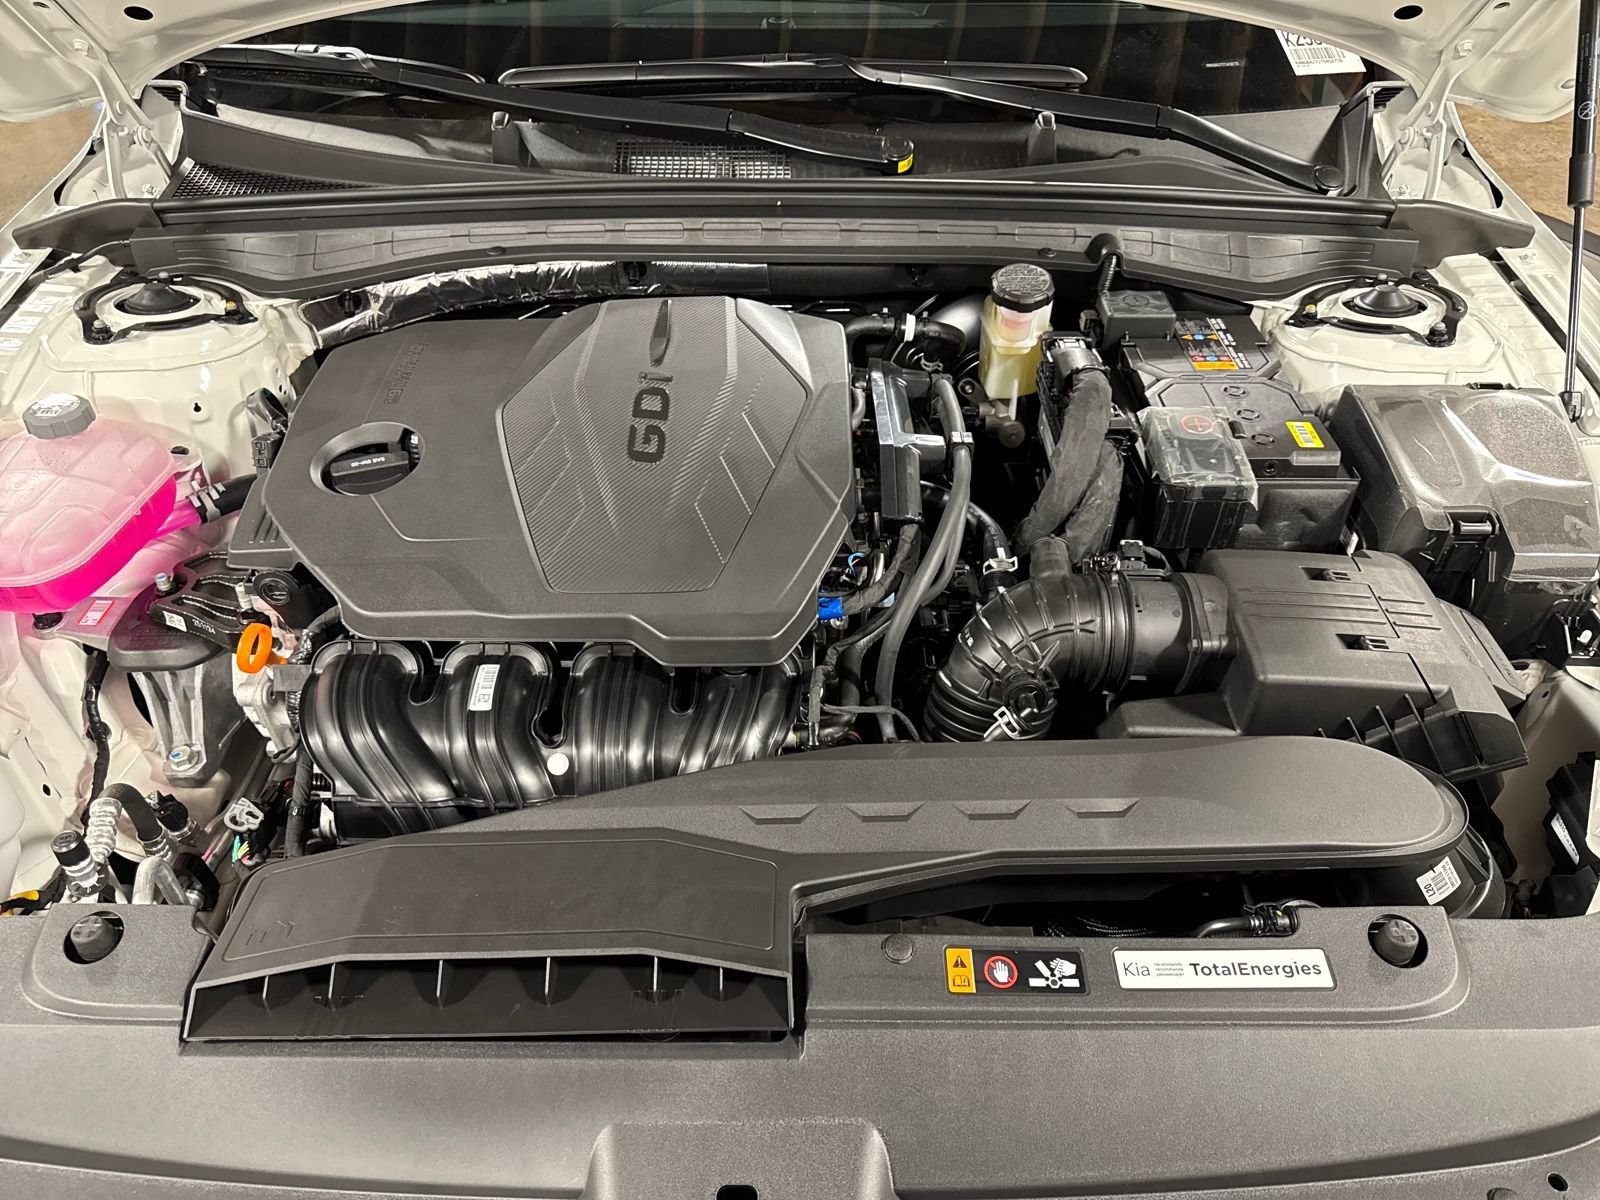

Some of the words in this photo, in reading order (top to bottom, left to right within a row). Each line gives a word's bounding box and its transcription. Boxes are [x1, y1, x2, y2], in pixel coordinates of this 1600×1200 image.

[627, 371, 673, 463] GDi
[1424, 883, 1436, 897] L20
[1123, 962, 1151, 977] Kia
[1189, 962, 1322, 978] TotalEnergies
